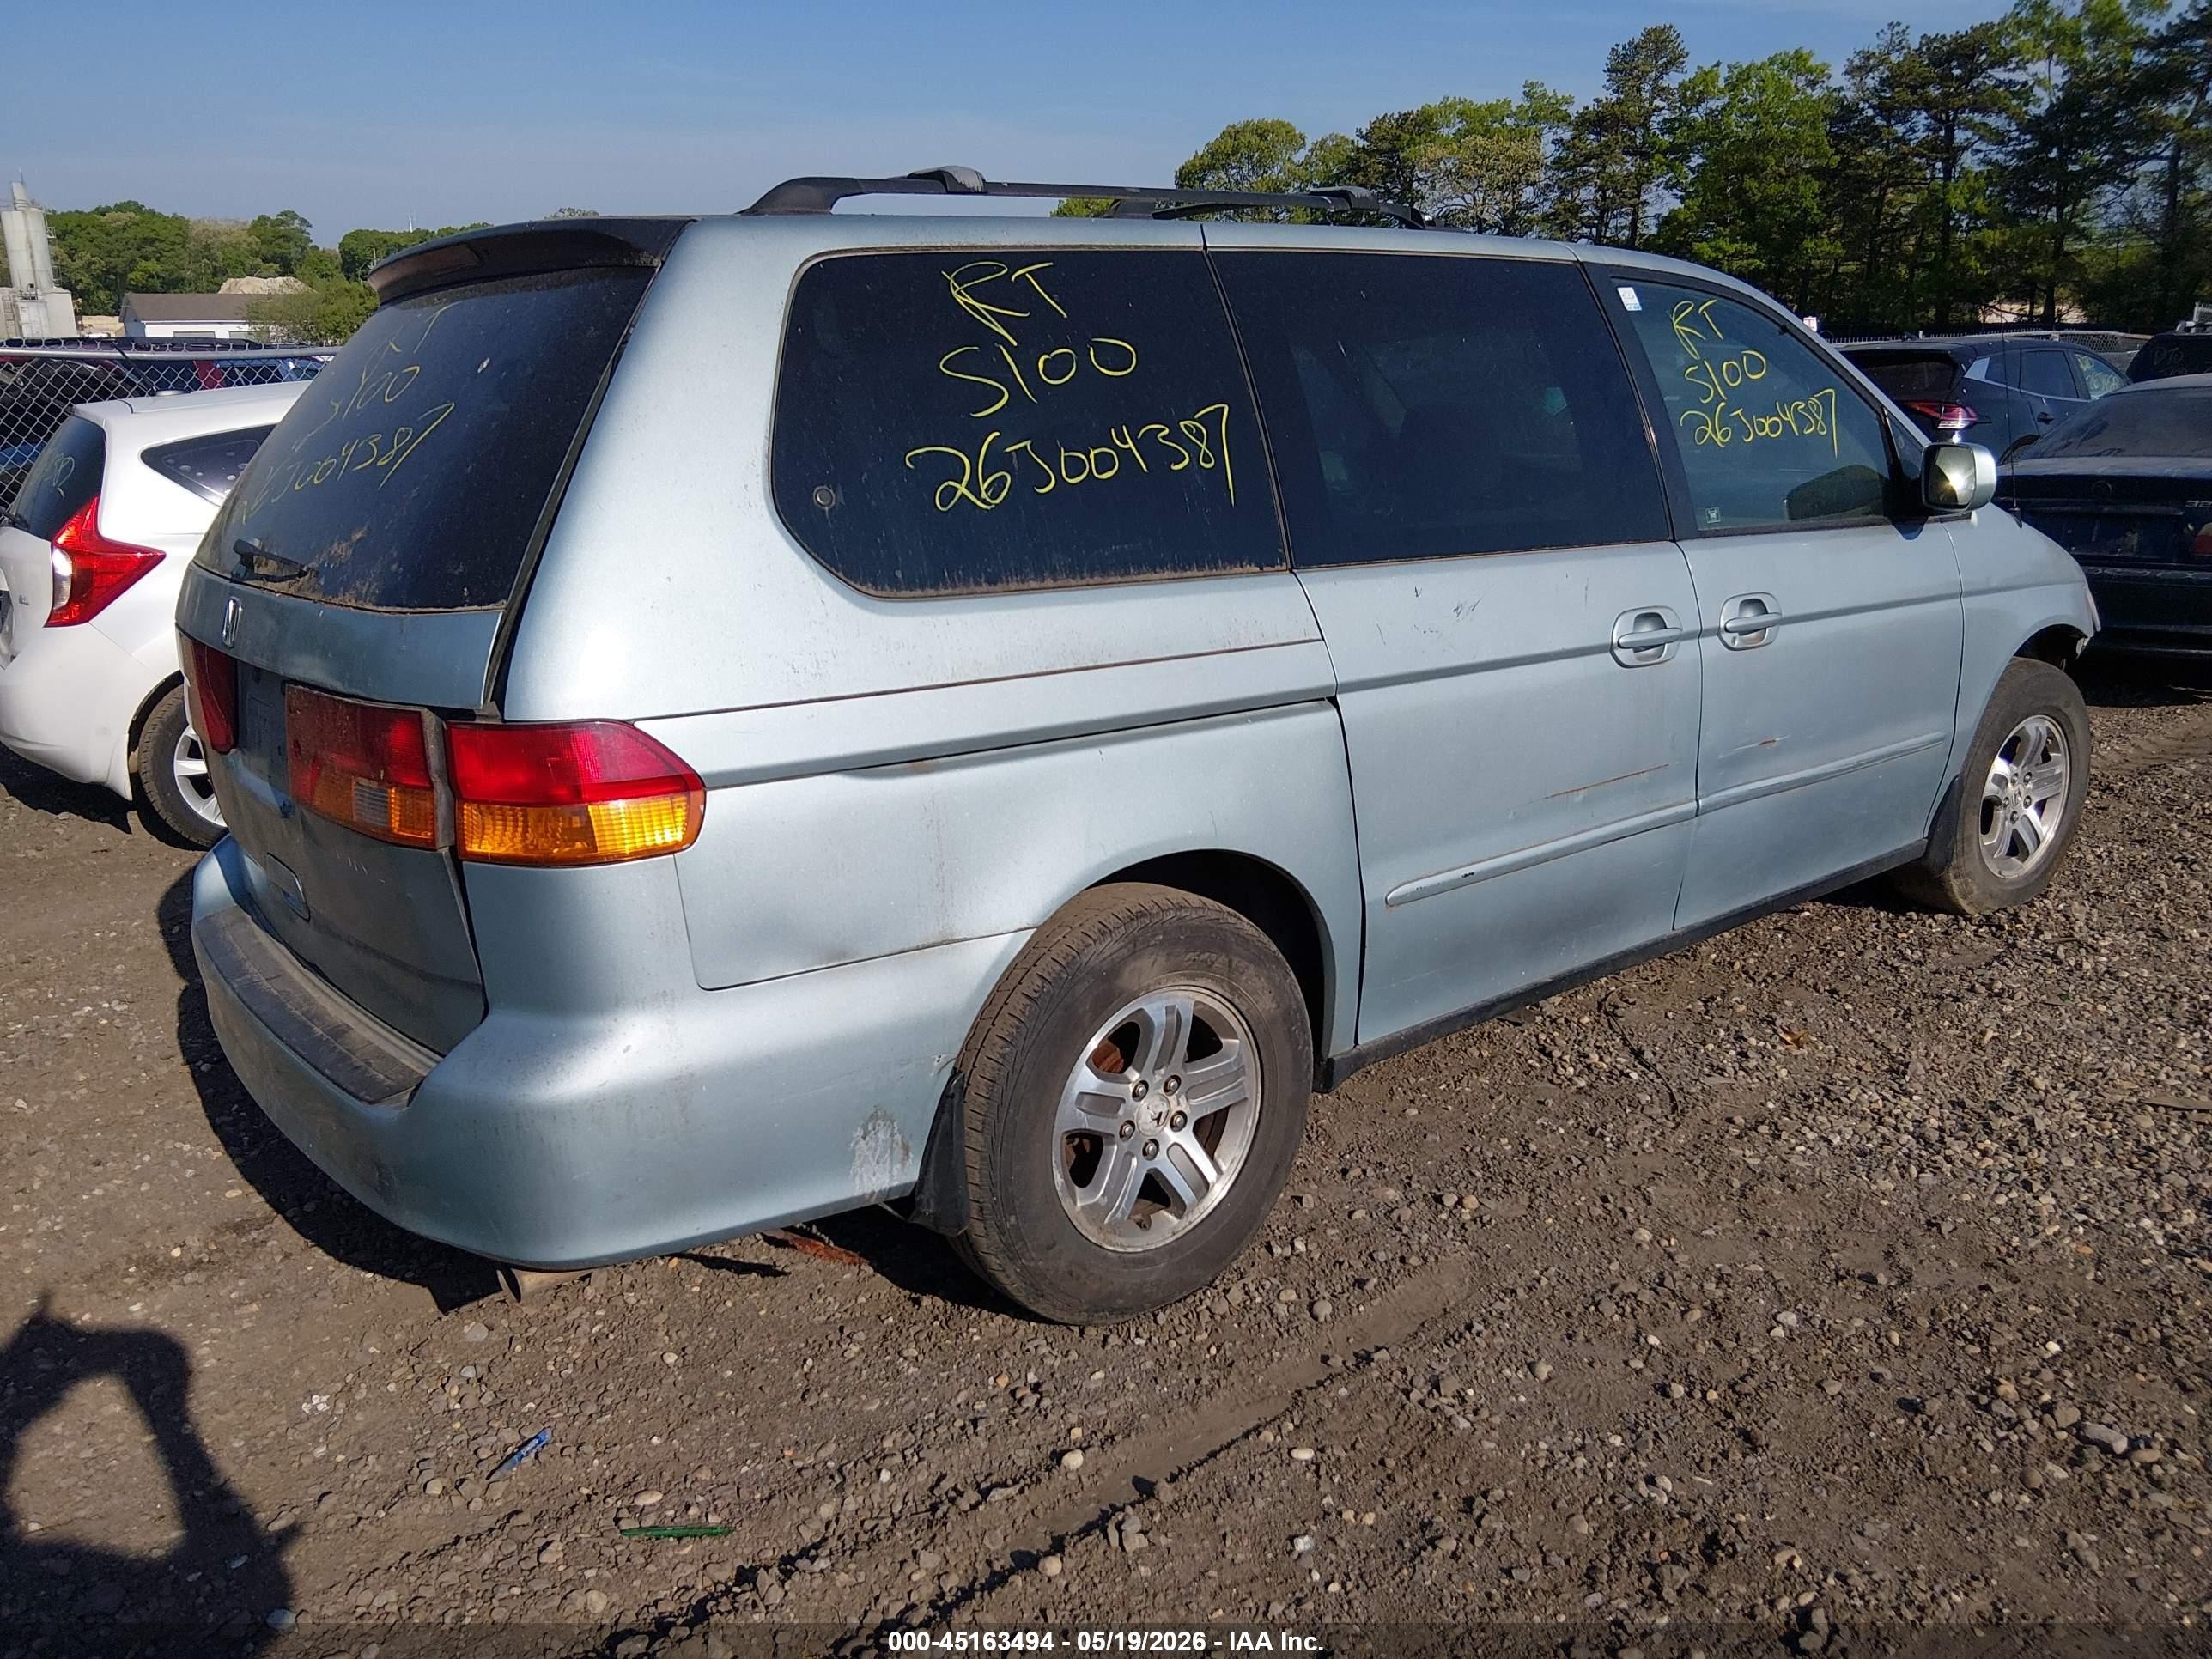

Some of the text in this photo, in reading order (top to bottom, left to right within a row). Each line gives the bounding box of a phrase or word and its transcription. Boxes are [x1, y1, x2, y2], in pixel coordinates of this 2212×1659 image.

[941, 261, 1067, 345] RT
[1668, 299, 1723, 360] RT
[939, 337, 1137, 417] S100
[1684, 349, 1766, 404] S100
[905, 404, 1235, 511] 26J004387
